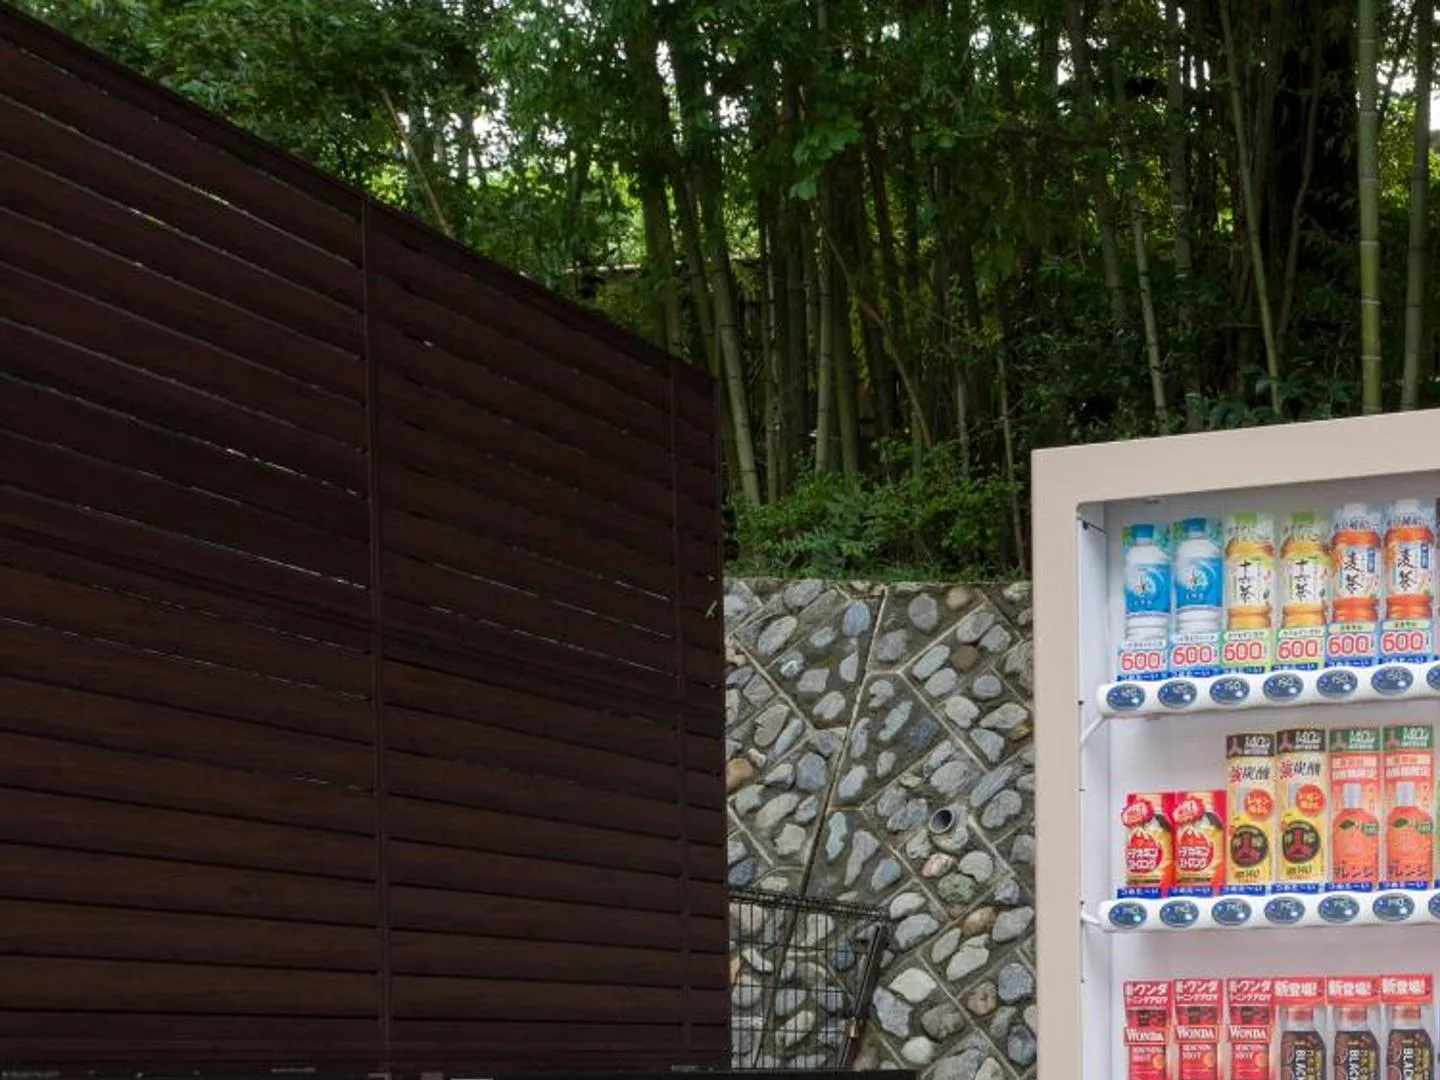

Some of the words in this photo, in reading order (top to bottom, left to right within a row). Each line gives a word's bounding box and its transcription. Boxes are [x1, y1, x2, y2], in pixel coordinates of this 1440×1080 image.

[1278, 640, 1319, 659] 600
[1328, 635, 1370, 654] 600
[1382, 631, 1425, 651] 600
[1173, 645, 1213, 665] 600
[1224, 642, 1263, 661] 600
[1122, 652, 1161, 671] 600
[1177, 1025, 1214, 1039] WONDA
[1229, 1025, 1267, 1039] WONDA
